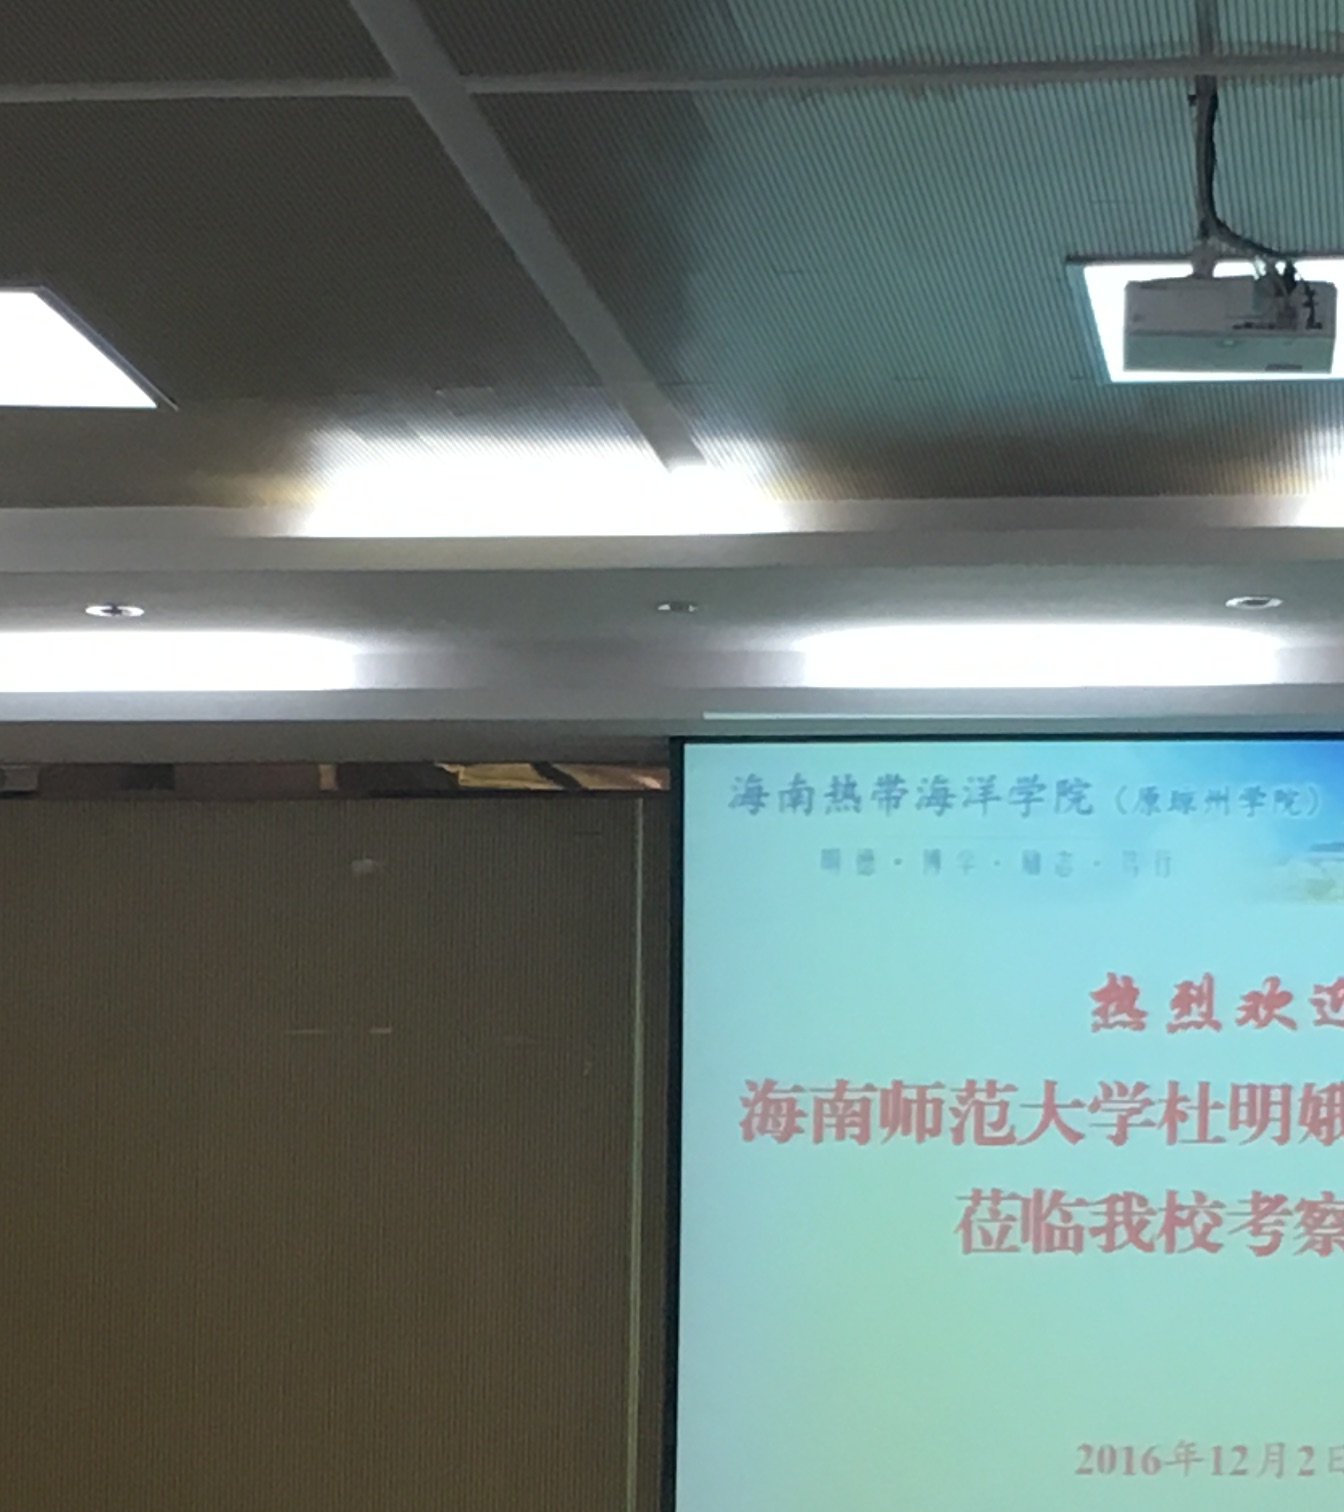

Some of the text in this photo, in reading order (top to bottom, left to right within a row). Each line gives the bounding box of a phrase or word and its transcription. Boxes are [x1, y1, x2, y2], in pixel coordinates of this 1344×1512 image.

[728, 772, 1095, 818] 海南热带海洋学院
